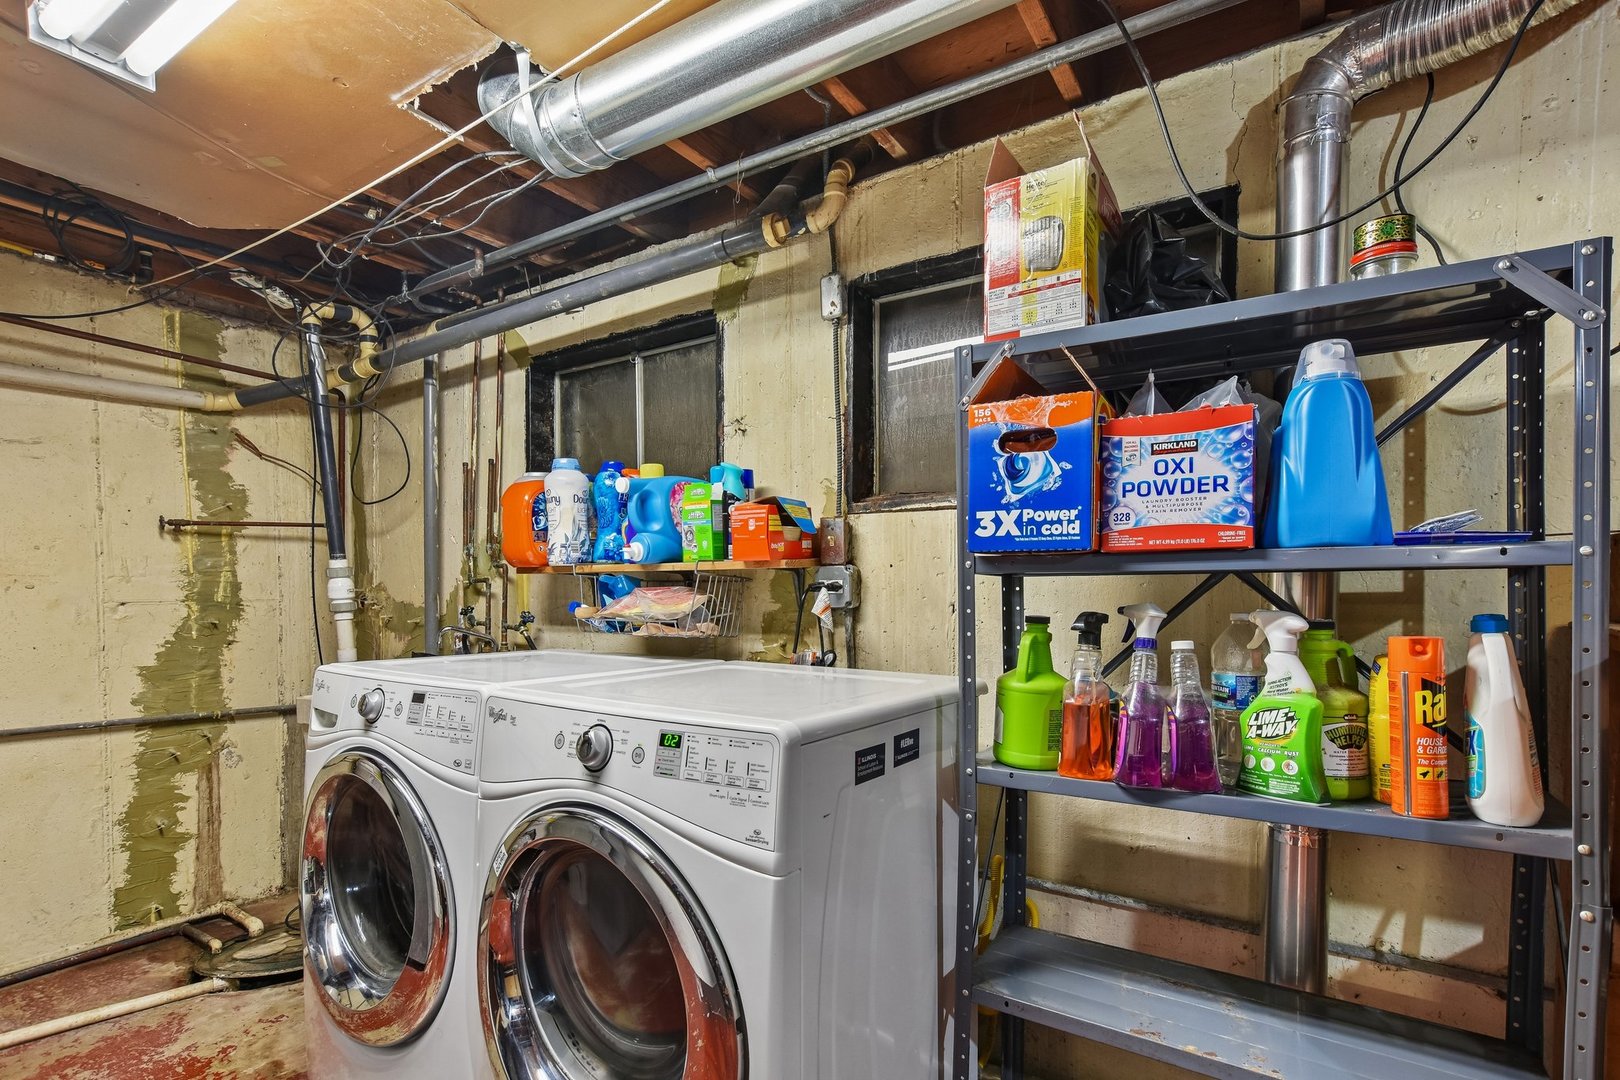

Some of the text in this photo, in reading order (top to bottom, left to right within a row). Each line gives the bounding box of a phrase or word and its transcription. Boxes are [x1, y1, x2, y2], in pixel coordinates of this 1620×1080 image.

[974, 408, 991, 417] 156
[1153, 441, 1197, 450] KIRKLAND
[1154, 456, 1194, 476] OXI
[1122, 475, 1230, 498] POWDER
[974, 509, 1021, 537] 3X
[1113, 513, 1130, 522] 328
[1023, 520, 1080, 535] in cold
[1415, 686, 1446, 724] Rai
[1248, 708, 1295, 726] LIME-
[1246, 719, 1299, 739] A-WAY
[1325, 725, 1368, 740] HUMIDIFIE
[664, 734, 679, 746] 02
[1334, 734, 1364, 747] HELPER
[1417, 737, 1443, 745] HOUSE
[1417, 746, 1447, 754] & GARDE
[862, 754, 876, 762] ILLINOIS
